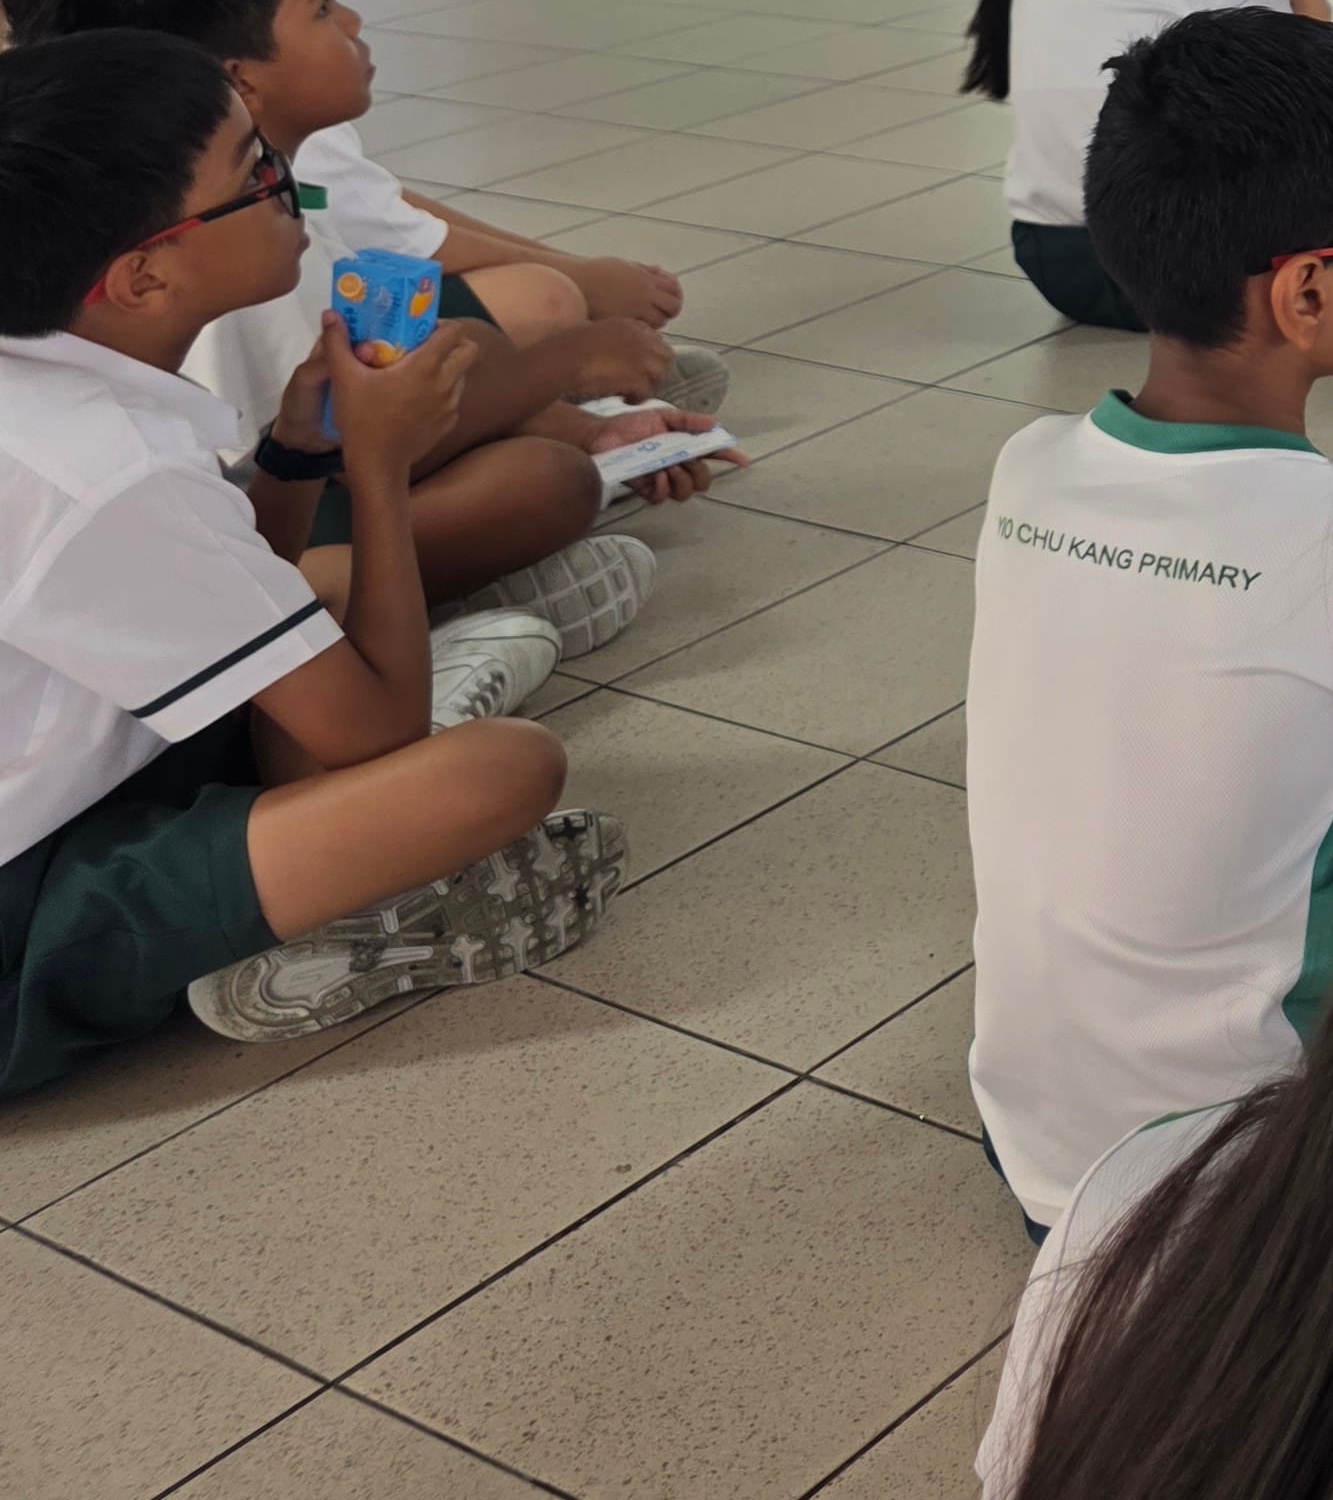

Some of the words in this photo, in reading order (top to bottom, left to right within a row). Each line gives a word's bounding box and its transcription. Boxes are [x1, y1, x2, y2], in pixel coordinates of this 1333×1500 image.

[1017, 522, 1066, 552] CHU
[1068, 536, 1134, 570] KANG
[1138, 552, 1263, 592] PRIMARY
